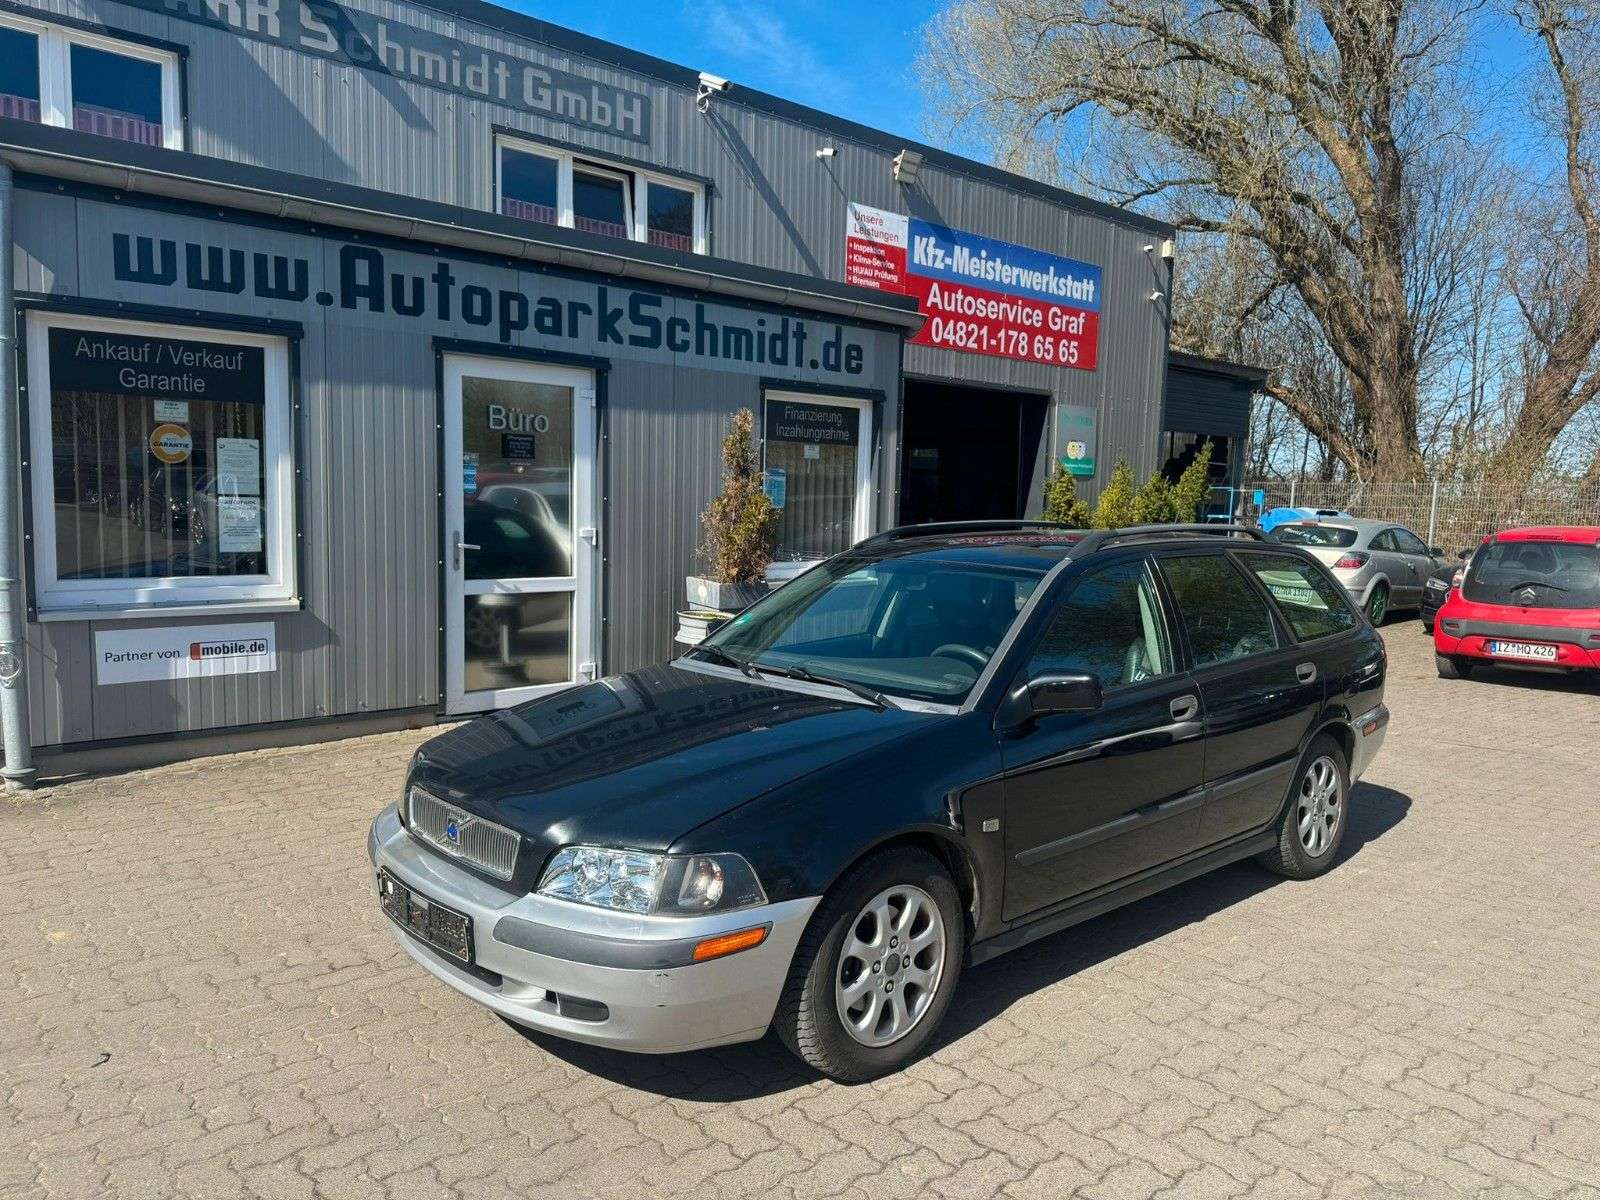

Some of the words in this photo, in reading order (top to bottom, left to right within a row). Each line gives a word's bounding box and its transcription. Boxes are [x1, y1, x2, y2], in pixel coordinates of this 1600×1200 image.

[300, 0, 511, 101] Schmidt
[523, 66, 642, 136] GmbH
[854, 210, 884, 226] Unsere
[854, 222, 899, 242] Leistungen
[853, 242, 886, 256] Inspektion
[853, 254, 895, 270] Klima-Service
[913, 235, 1095, 302] Kfz-Meisterwerkstatt
[852, 275, 880, 289] Bremsen
[874, 268, 899, 284] Prüfung
[112, 232, 864, 375] www.AutoparkSchmidt.de
[926, 282, 1043, 328] Autoservice
[1048, 306, 1086, 335] Graf
[931, 316, 1029, 357] 04821-178
[1033, 335, 1055, 360] 65
[1058, 339, 1079, 364] 65
[75, 336, 151, 363] Ankauf
[156, 344, 163, 364] /
[168, 345, 244, 371] Verkauf
[119, 367, 206, 393] Garantie
[488, 404, 550, 434] Büro
[784, 406, 843, 427] Finanzierung
[776, 423, 851, 442] Inzahlungnahme
[153, 440, 190, 449] GARANTIE
[105, 651, 152, 663] Partner
[158, 649, 182, 660] von
[201, 641, 266, 657] mobile.de
[1498, 642, 1510, 653] IZ
[1516, 644, 1532, 655] MQ
[1534, 645, 1554, 657] 426
